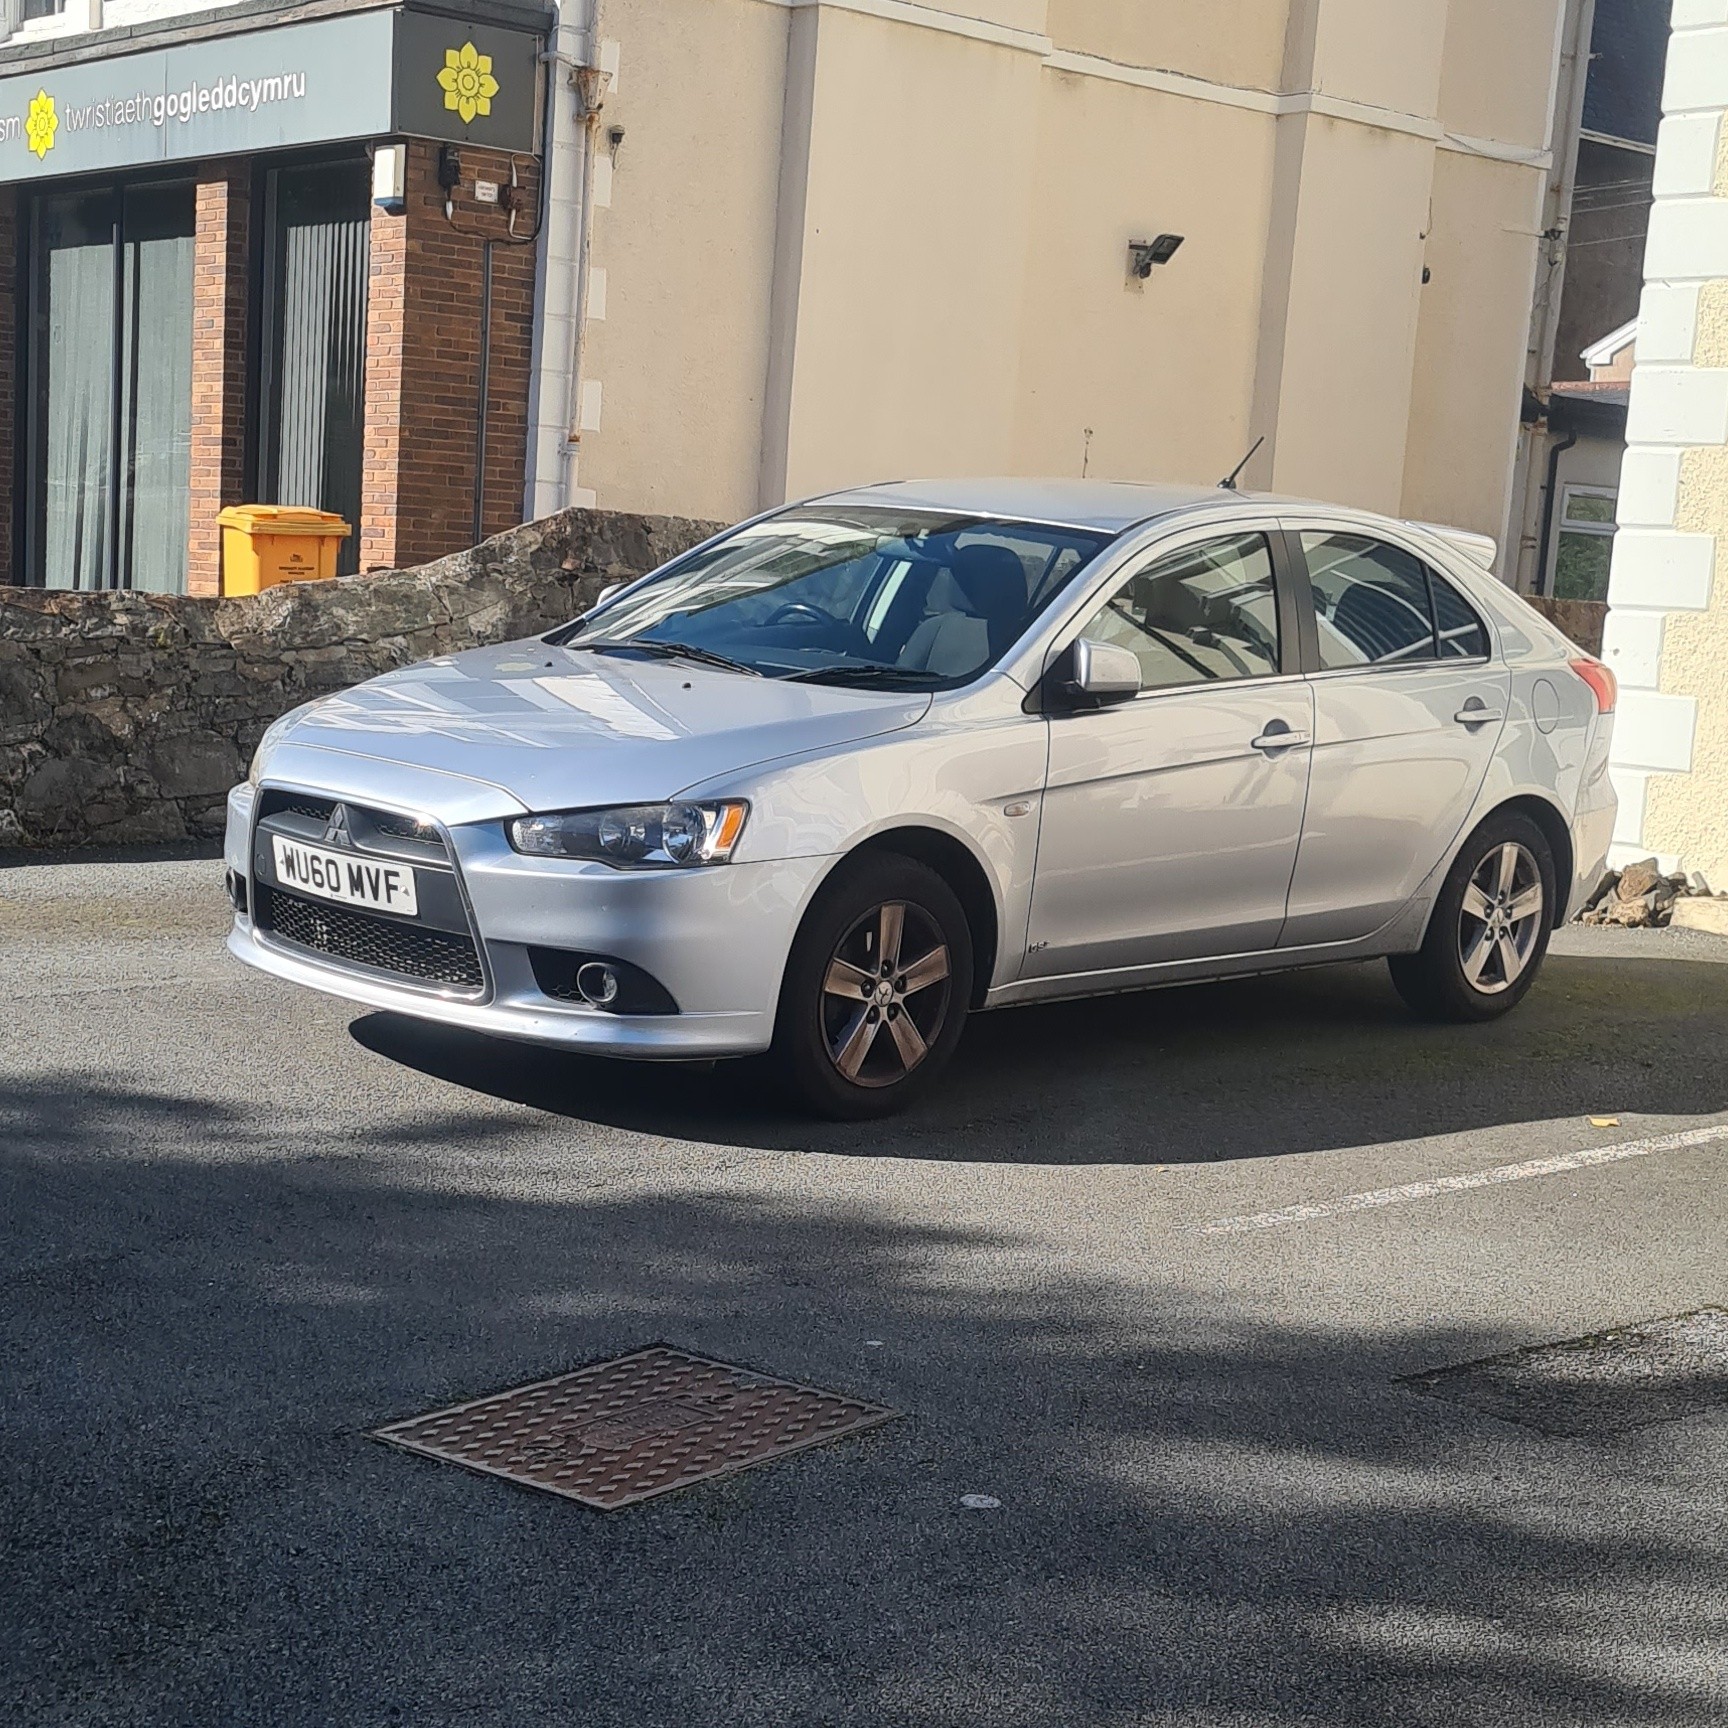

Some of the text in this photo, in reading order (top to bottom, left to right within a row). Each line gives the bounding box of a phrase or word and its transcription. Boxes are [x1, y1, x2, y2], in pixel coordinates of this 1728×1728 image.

[65, 72, 306, 132] twristiaethgogleddcymru
[282, 845, 400, 904] WU60 MVF
